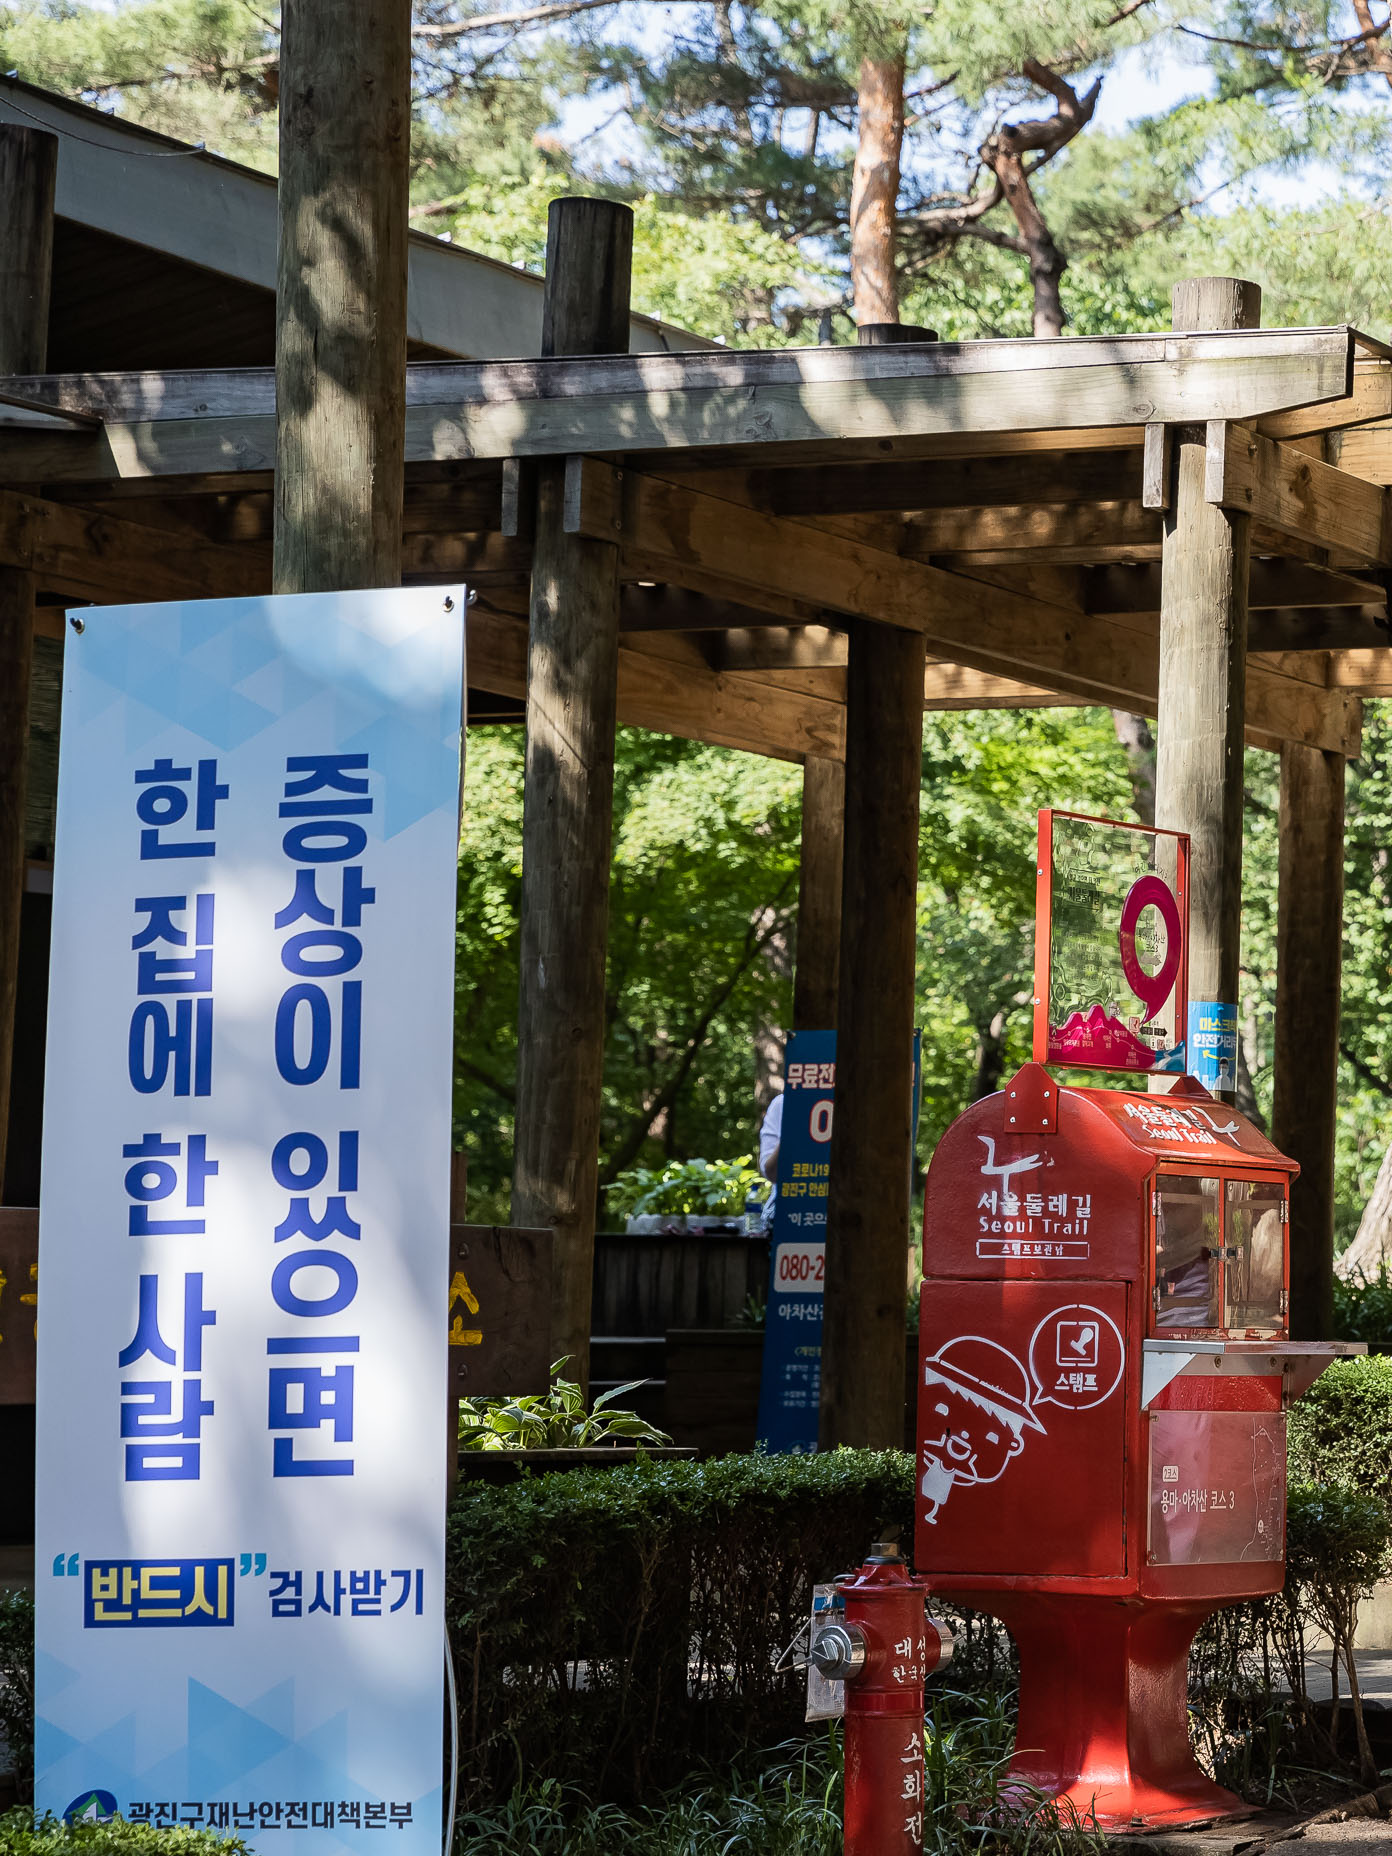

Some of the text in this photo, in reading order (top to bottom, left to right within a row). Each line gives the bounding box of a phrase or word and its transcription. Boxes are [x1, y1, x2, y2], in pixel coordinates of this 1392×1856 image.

[119, 758, 230, 1482] 한 집에 한 사람
[266, 752, 376, 1477] 증상이 있으면
[1123, 1103, 1206, 1129] 서울둘레길
[1142, 1124, 1217, 1145] Seoul Trail
[977, 1190, 1091, 1219] 서울둘레길
[979, 1216, 1088, 1236] Seoul Trail
[1054, 1371, 1098, 1393] 스탬프
[1209, 1490, 1227, 1510] 코스
[1229, 1490, 1235, 1510] 3
[269, 1568, 424, 1618] 검사받기
[900, 1732, 923, 1846] 소화전
[128, 1801, 414, 1830] 광진구재난안전대책본부
